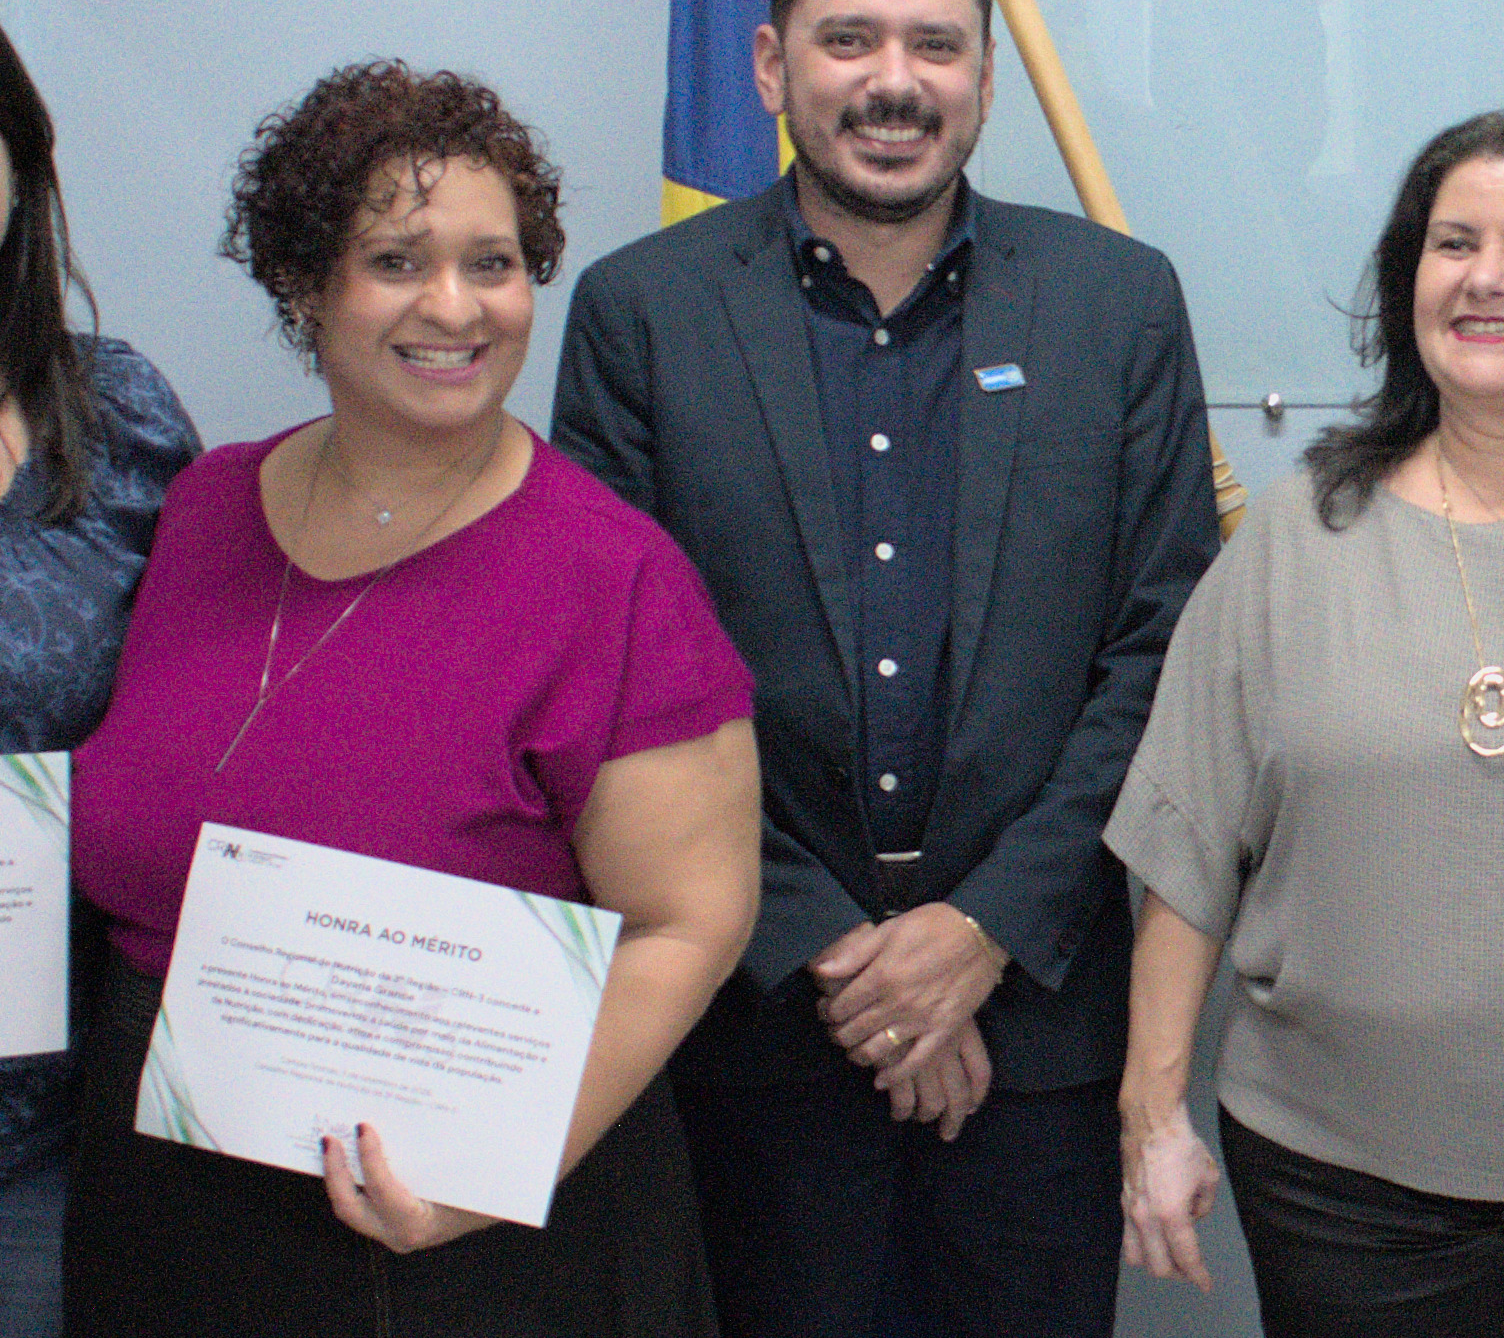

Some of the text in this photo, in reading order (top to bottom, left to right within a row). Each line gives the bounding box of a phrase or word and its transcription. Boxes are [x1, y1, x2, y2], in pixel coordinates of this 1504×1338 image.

[304, 910, 484, 961] HONRA AO MÉRITO
